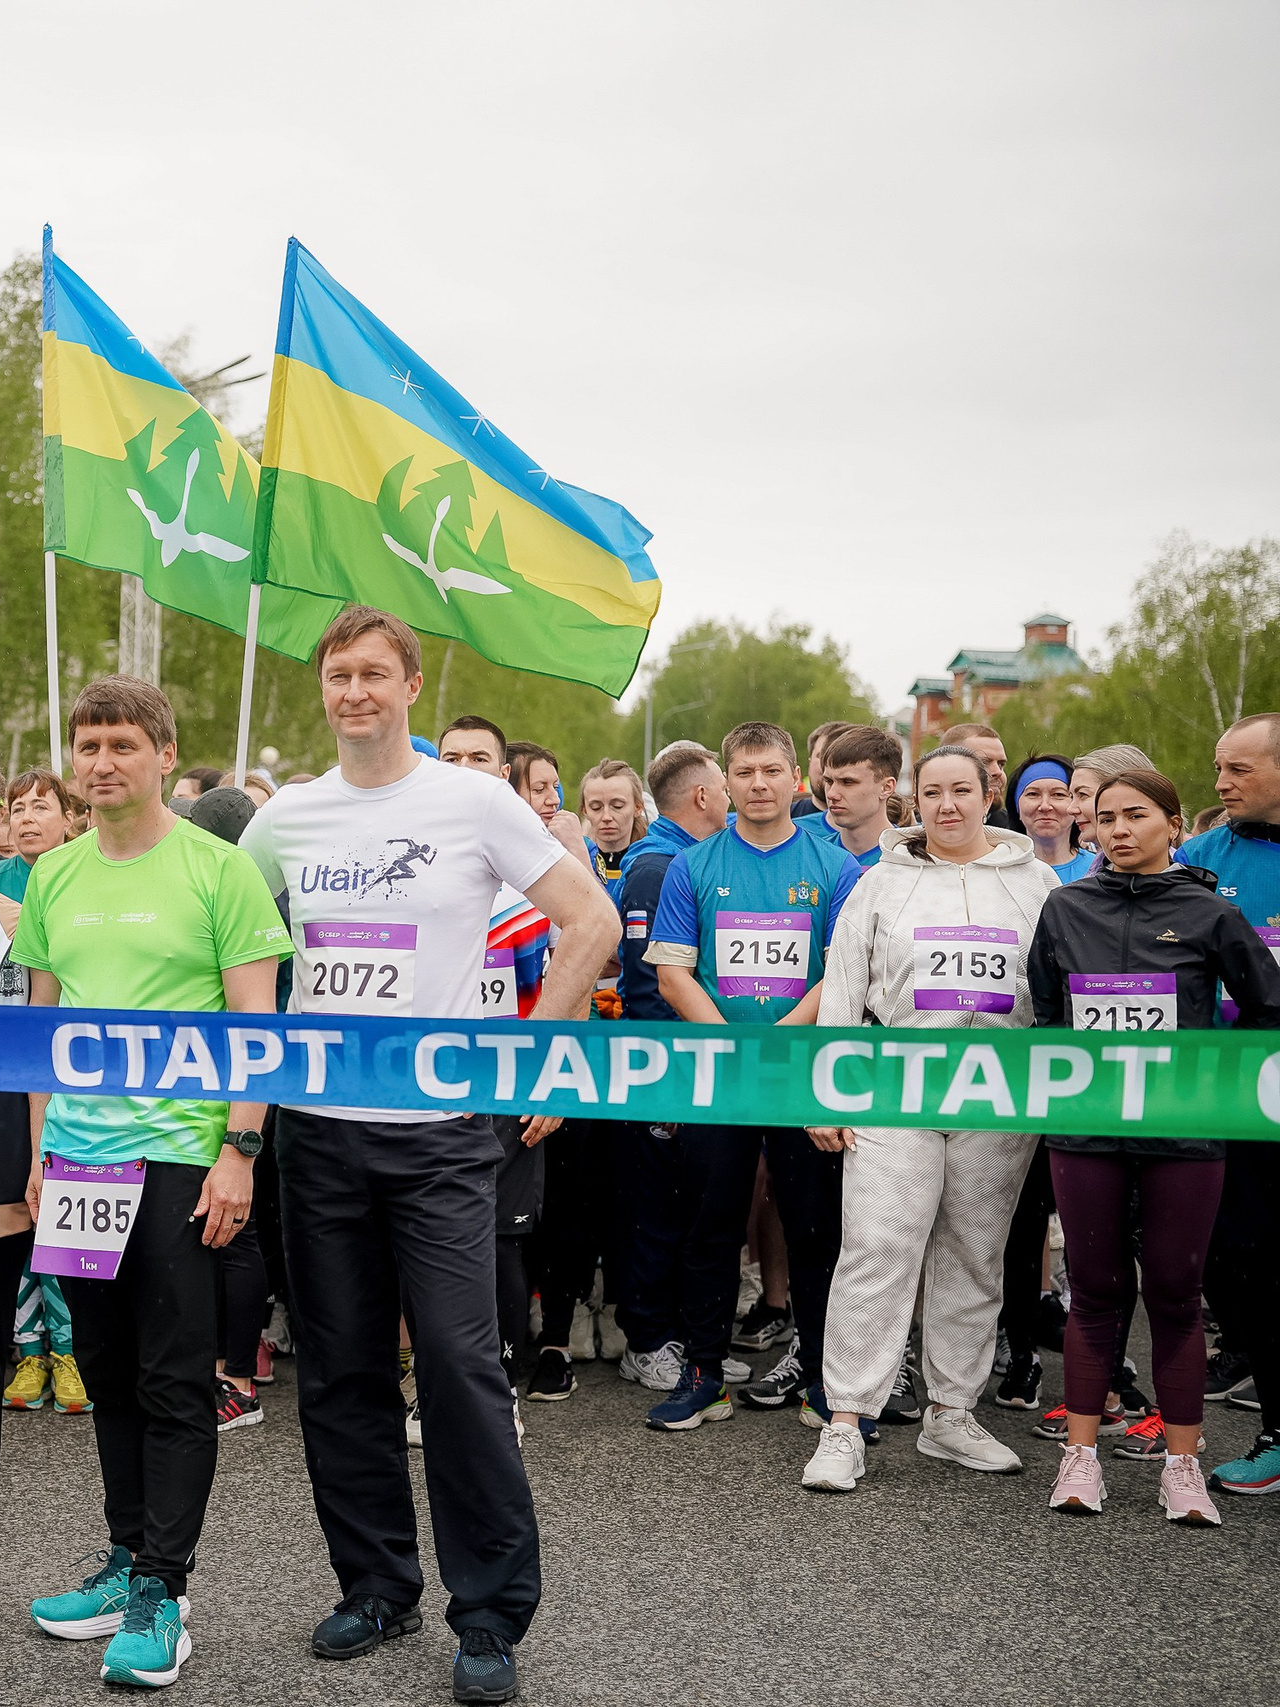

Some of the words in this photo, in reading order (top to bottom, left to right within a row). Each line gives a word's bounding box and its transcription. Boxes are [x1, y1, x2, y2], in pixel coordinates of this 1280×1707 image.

[301, 864, 375, 894] Utair
[266, 930, 290, 942] рит
[729, 940, 800, 966] 2154
[313, 961, 399, 999] 2072
[930, 951, 1007, 980] 2153
[1085, 1007, 1164, 1030] 2152
[50, 1022, 344, 1095] СТАРТ
[414, 1031, 737, 1107] СТАРТ
[811, 1040, 1172, 1121] СТАРТ
[56, 1196, 132, 1234] 2185
